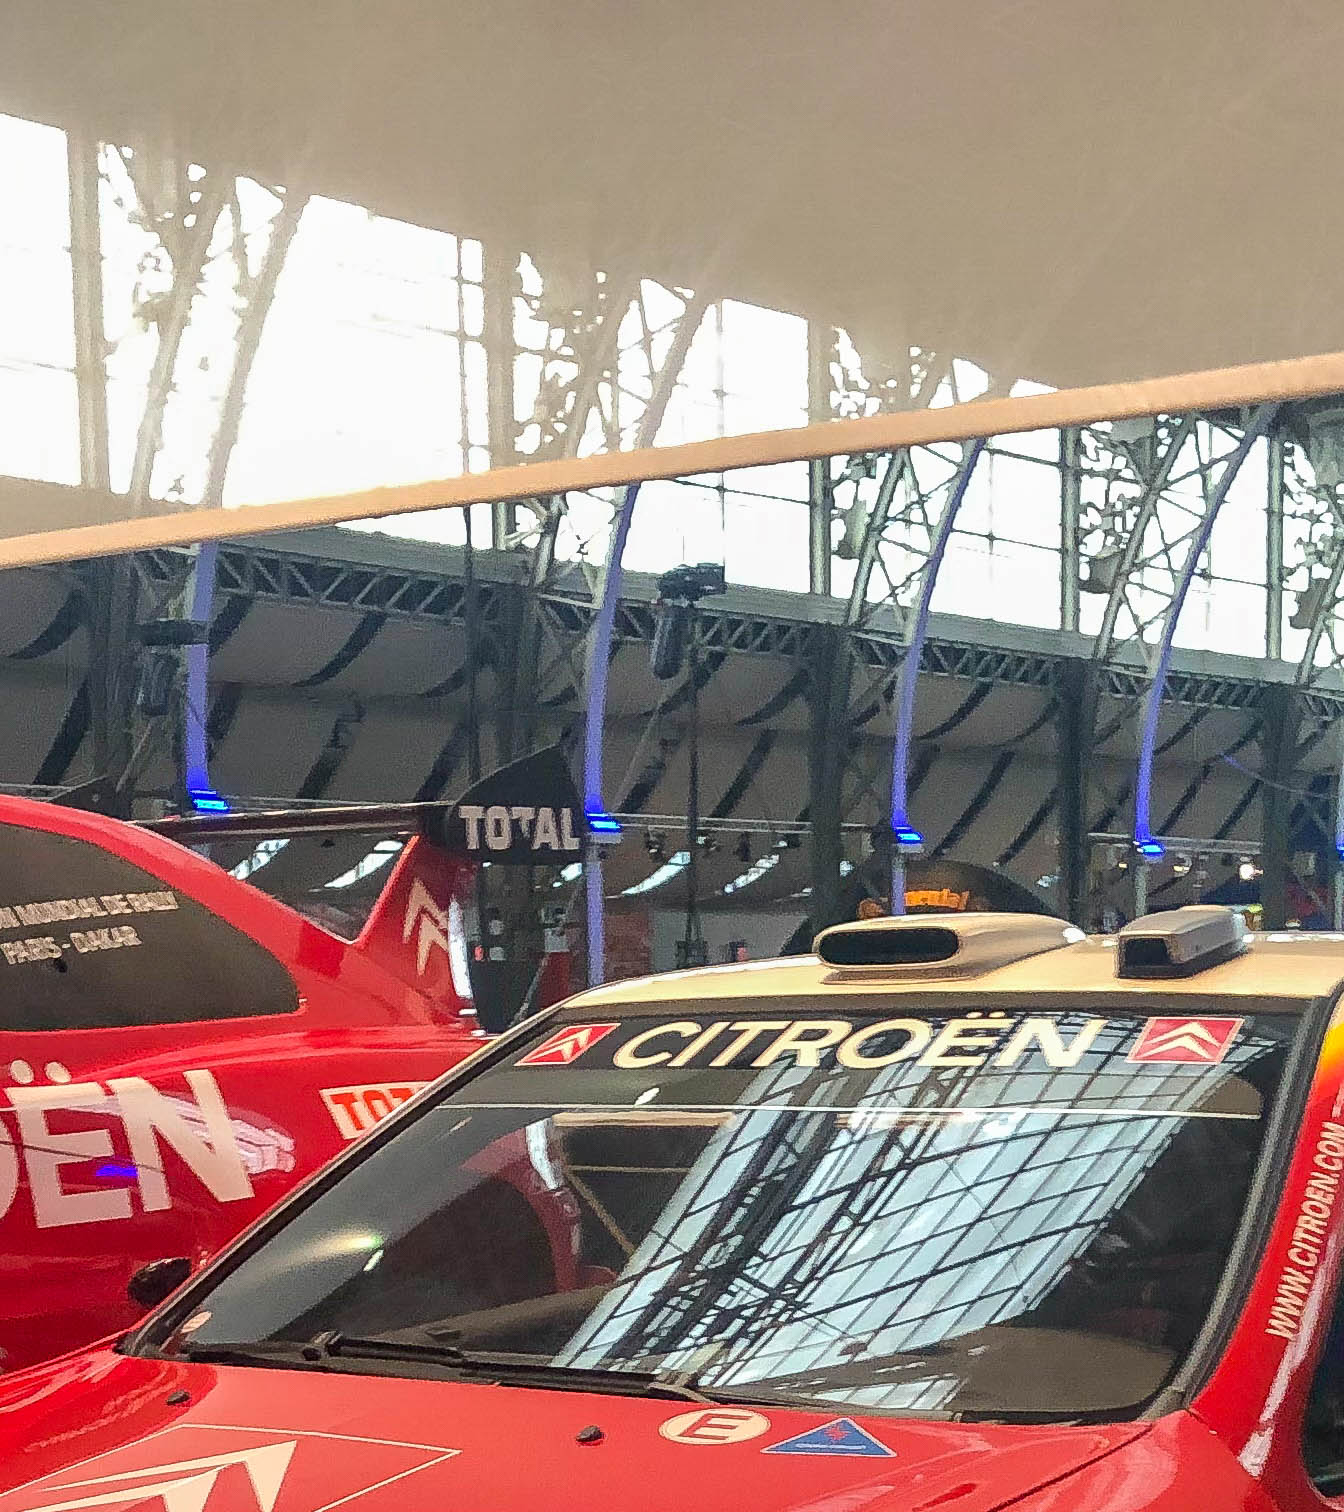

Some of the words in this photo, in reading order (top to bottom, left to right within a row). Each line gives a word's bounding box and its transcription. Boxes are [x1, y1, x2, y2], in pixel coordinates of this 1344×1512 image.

[458, 804, 581, 851] TOTAL
[70, 925, 144, 954] DAKAR
[611, 1010, 1110, 1070] CITROËN
[677, 1412, 754, 1441] E
